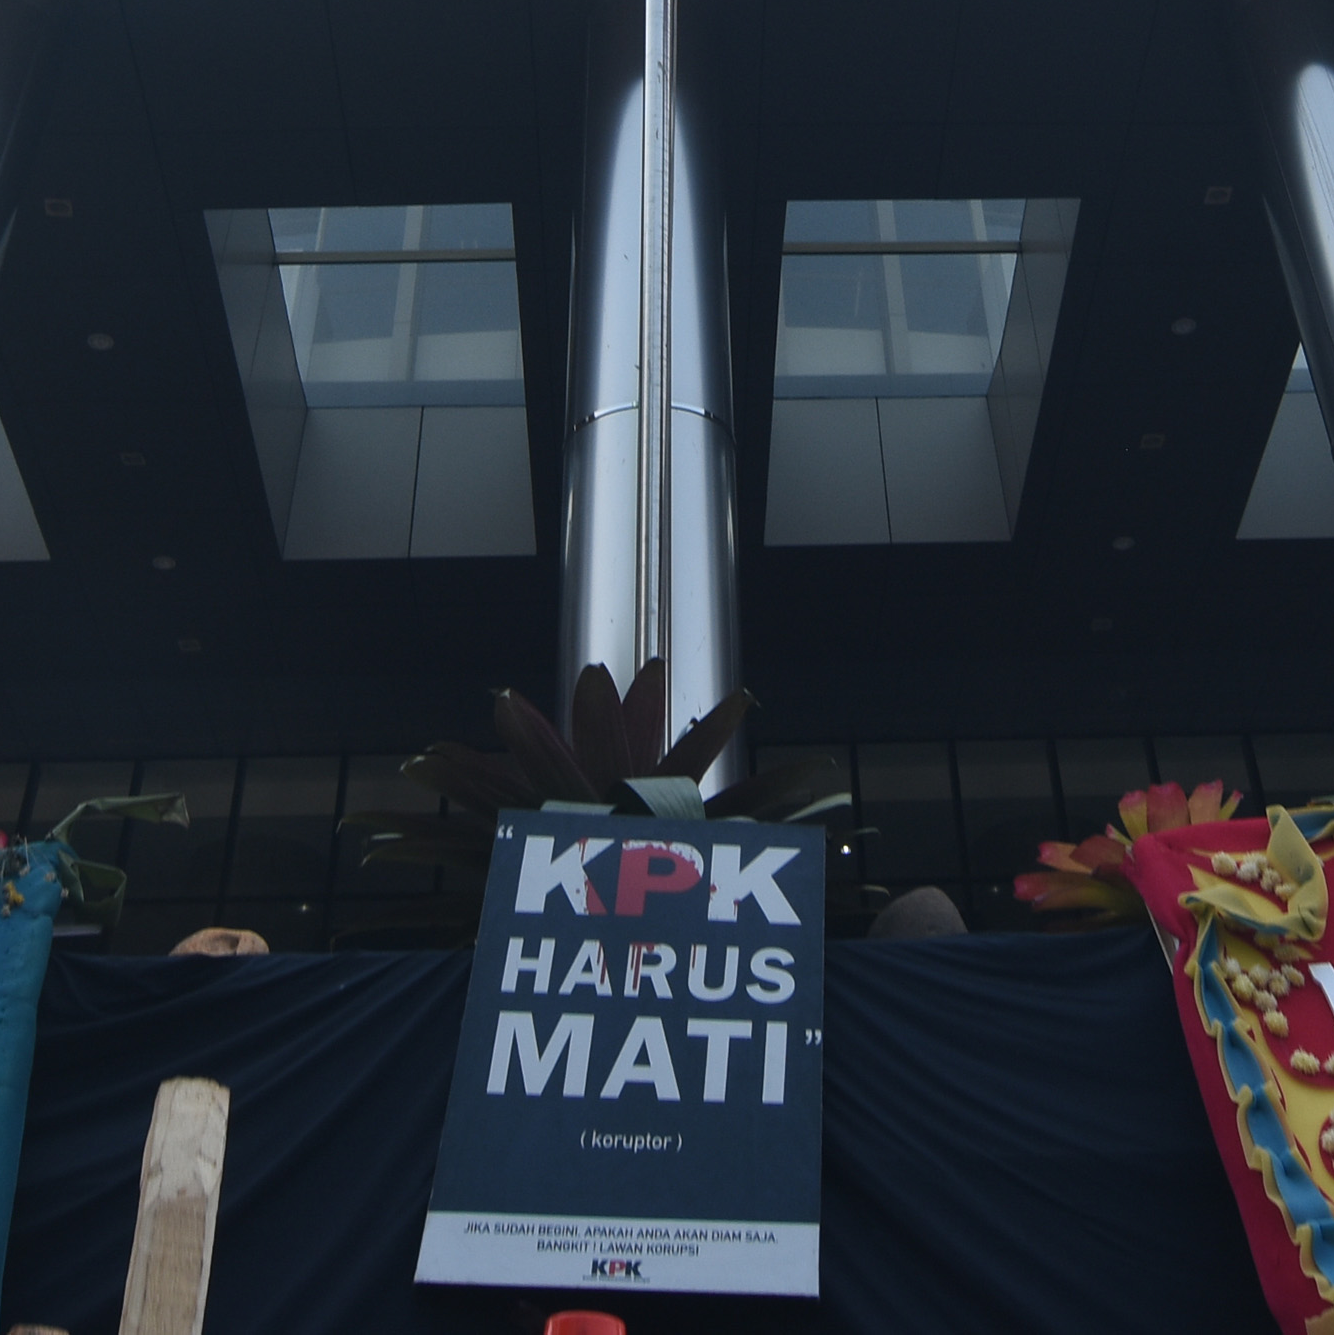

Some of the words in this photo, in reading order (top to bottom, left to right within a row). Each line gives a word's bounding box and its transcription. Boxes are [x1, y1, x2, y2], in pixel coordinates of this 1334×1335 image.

[500, 937, 796, 1003] HARUS
[464, 1222, 490, 1235] JIKA
[494, 1222, 535, 1237] SUDAH
[584, 1226, 633, 1239] APAKAH
[636, 1228, 670, 1241] ANDA
[674, 1229, 708, 1242] AKAN
[711, 1230, 742, 1242] DIAM
[599, 1242, 643, 1254] LAWAN
[646, 1243, 700, 1257] KORUPSI
[591, 1258, 642, 1278] KPK
